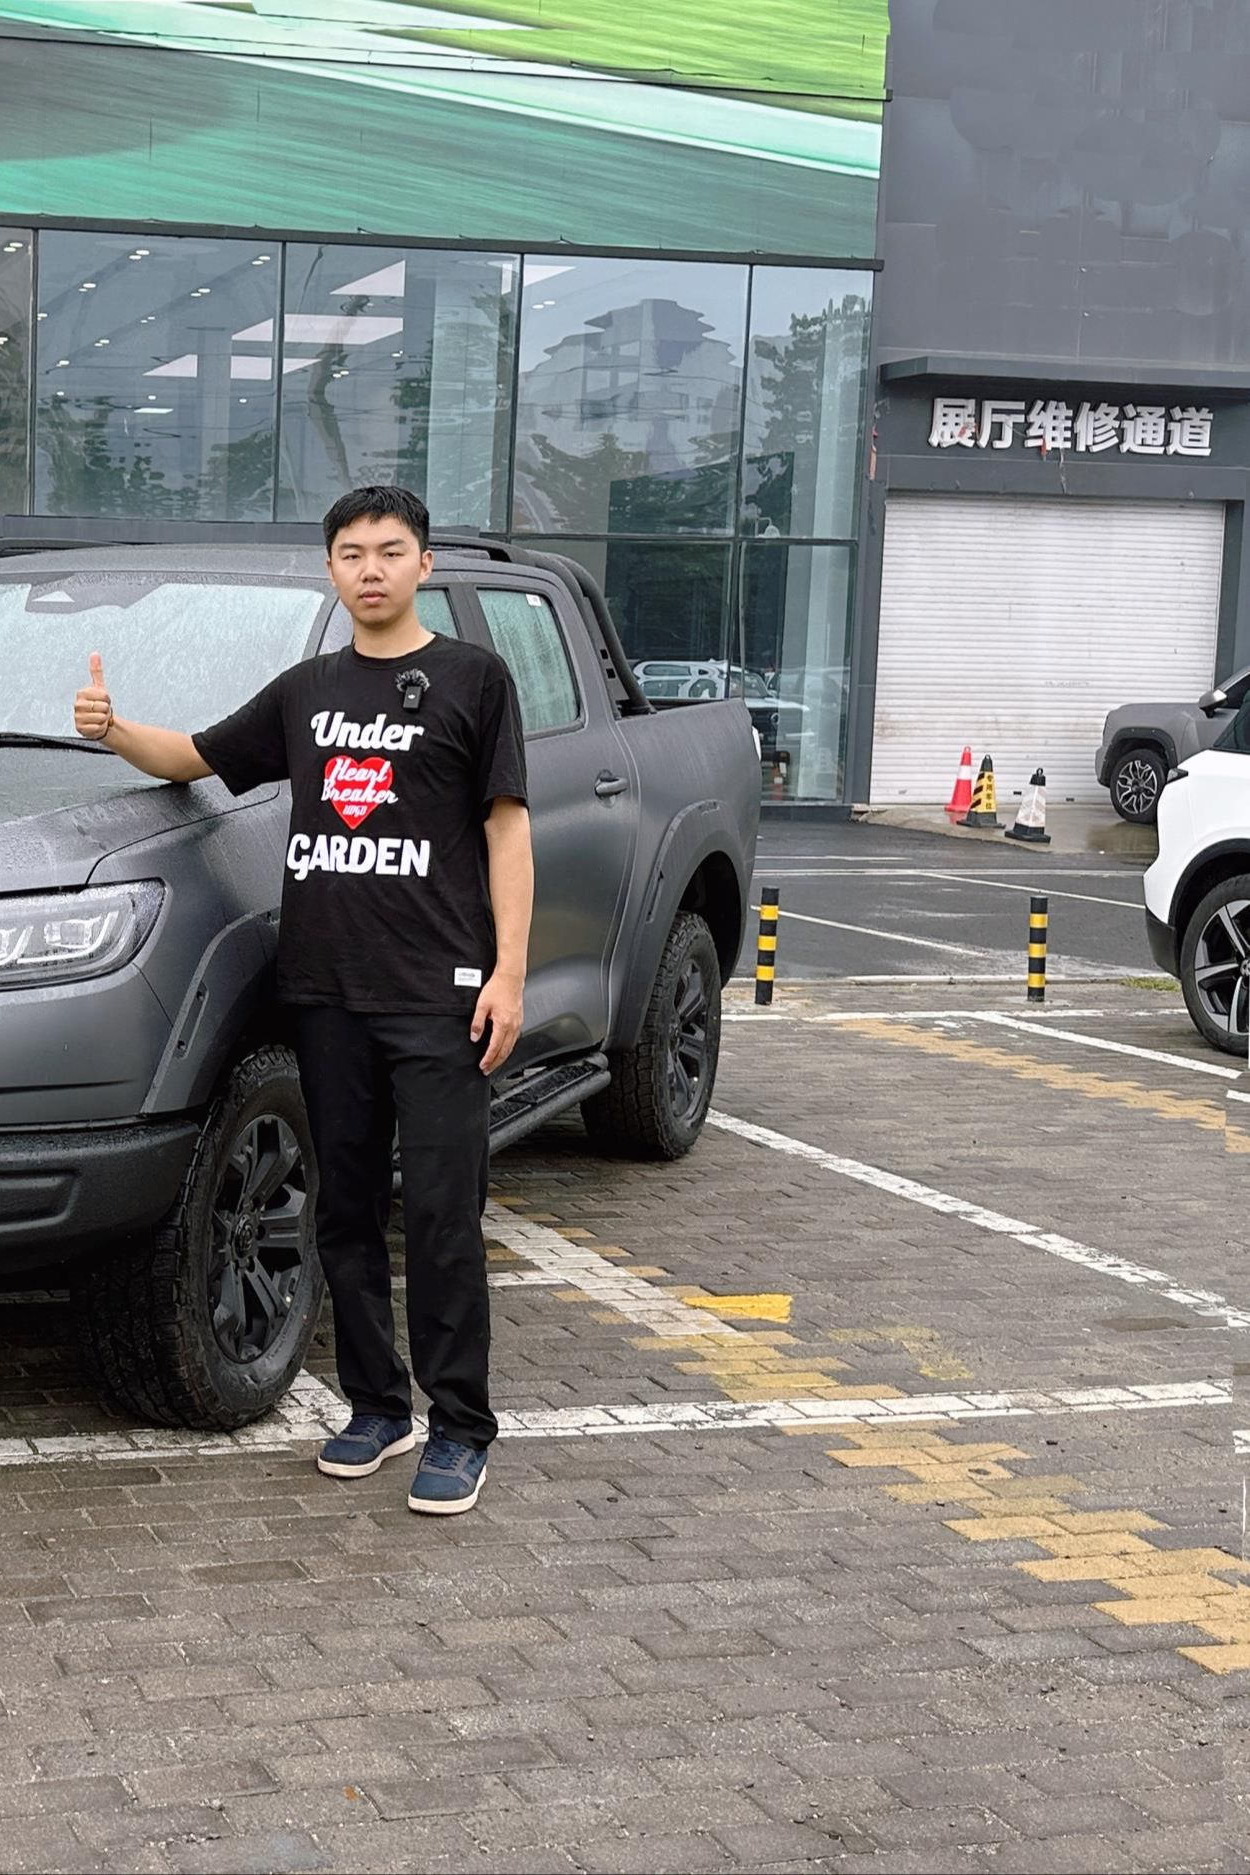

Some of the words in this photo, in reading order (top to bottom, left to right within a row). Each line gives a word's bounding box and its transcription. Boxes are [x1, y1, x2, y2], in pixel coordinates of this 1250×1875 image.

[928, 398, 1213, 457] 展厅维修通道
[310, 710, 425, 751] Under
[329, 758, 391, 783] Heart
[320, 778, 399, 805] Breaker
[286, 833, 430, 881] GARDEN
